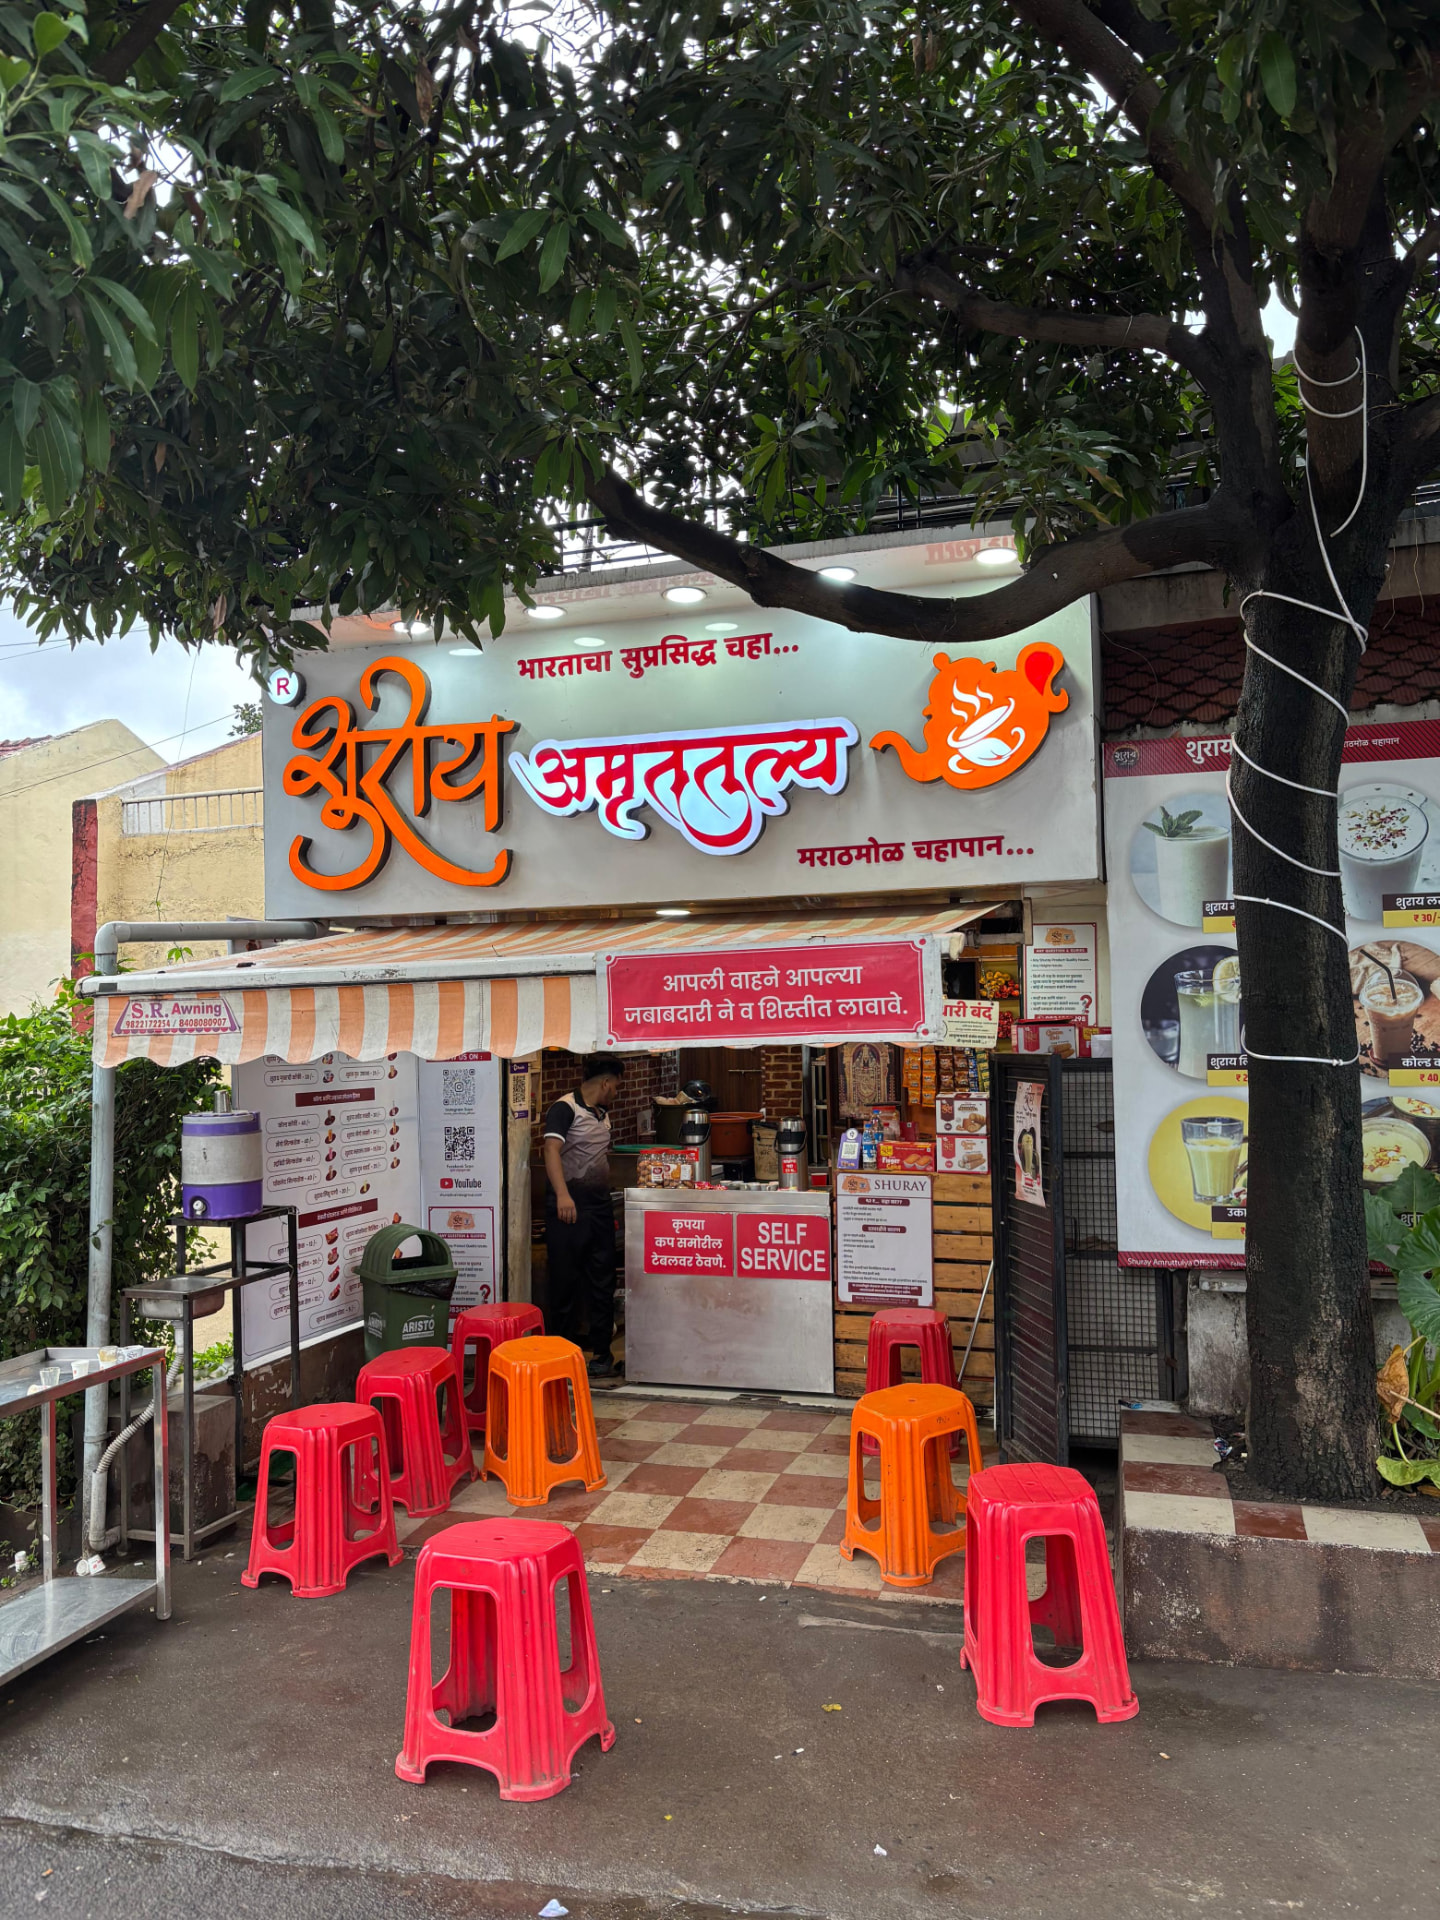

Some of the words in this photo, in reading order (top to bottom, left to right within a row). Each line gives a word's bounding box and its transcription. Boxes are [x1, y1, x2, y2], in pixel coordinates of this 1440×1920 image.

[517, 650, 612, 680] भारताचा
[620, 634, 717, 679] सुप्रसिद्ध
[1371, 736, 1400, 747] चहापान
[1186, 738, 1233, 765] शुराय
[512, 722, 852, 850] अमृततुल्य
[797, 837, 905, 868] मराठमोळ
[1205, 902, 1229, 915] शुराय
[1396, 896, 1425, 910] शुराय
[663, 967, 725, 992] आपली
[729, 965, 780, 991] वाहने
[786, 966, 863, 987] आपल्या
[131, 1002, 169, 1019] S.R.
[171, 1001, 222, 1017] Awning
[624, 998, 712, 1025] जबाबदारी
[717, 999, 734, 1021] ने
[740, 1002, 754, 1021] व
[758, 994, 832, 1020] शिस्तीत
[970, 1001, 993, 1021] बंद
[1210, 1057, 1237, 1069] शुराय
[1401, 1055, 1432, 1067] कोल्ड
[454, 1178, 482, 1188] YouTube
[874, 1179, 927, 1192] SHURAY
[672, 1218, 705, 1232] कृपया
[758, 1221, 807, 1245] SELF
[654, 1236, 675, 1249] कप
[676, 1232, 723, 1250] समोरील
[651, 1252, 693, 1268] टेबलवर
[740, 1247, 826, 1272] SERVICE
[1127, 1257, 1151, 1268] Shuray
[1152, 1258, 1193, 1269] Amruttulya
[1193, 1258, 1219, 1268] Official
[402, 1318, 435, 1334] ARISTO
